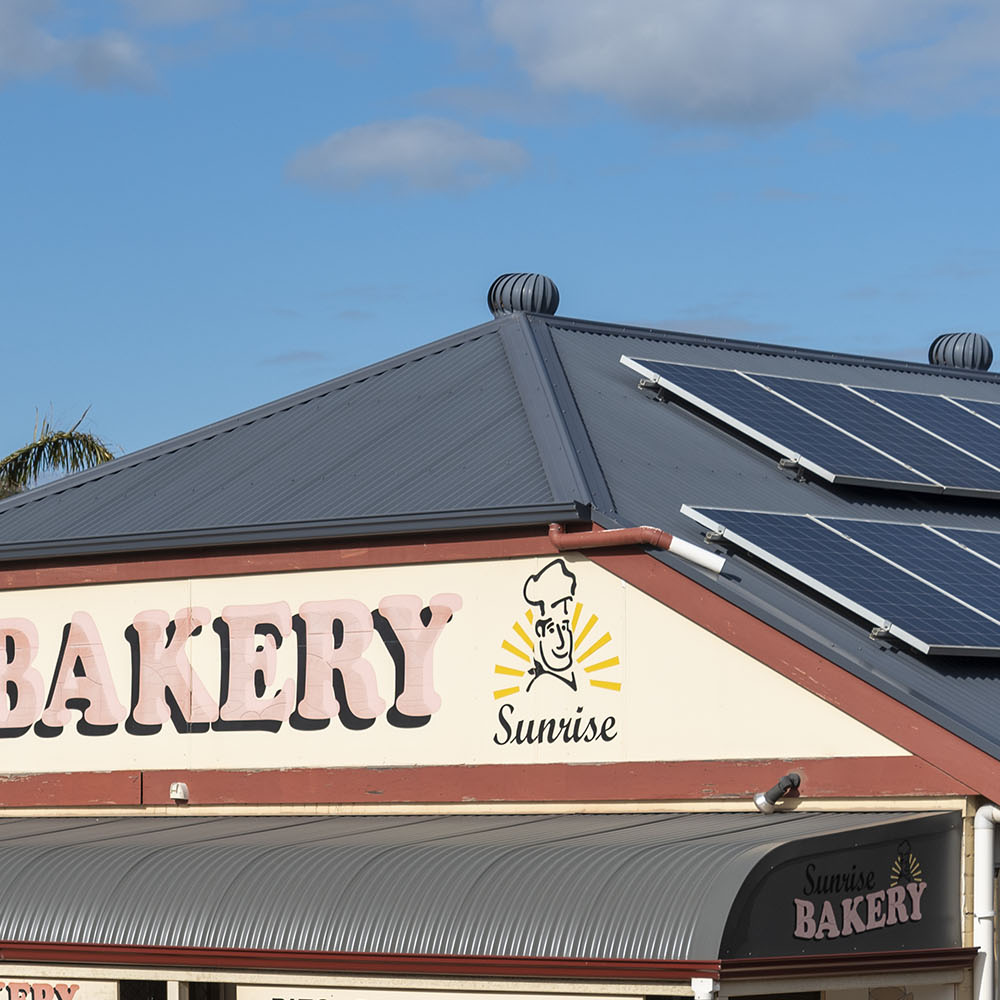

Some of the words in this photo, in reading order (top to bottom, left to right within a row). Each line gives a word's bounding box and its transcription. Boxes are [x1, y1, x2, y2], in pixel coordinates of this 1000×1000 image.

[493, 703, 618, 746] Sunrise
[804, 863, 876, 896] Sunrise
[793, 881, 928, 940] BAKERY
